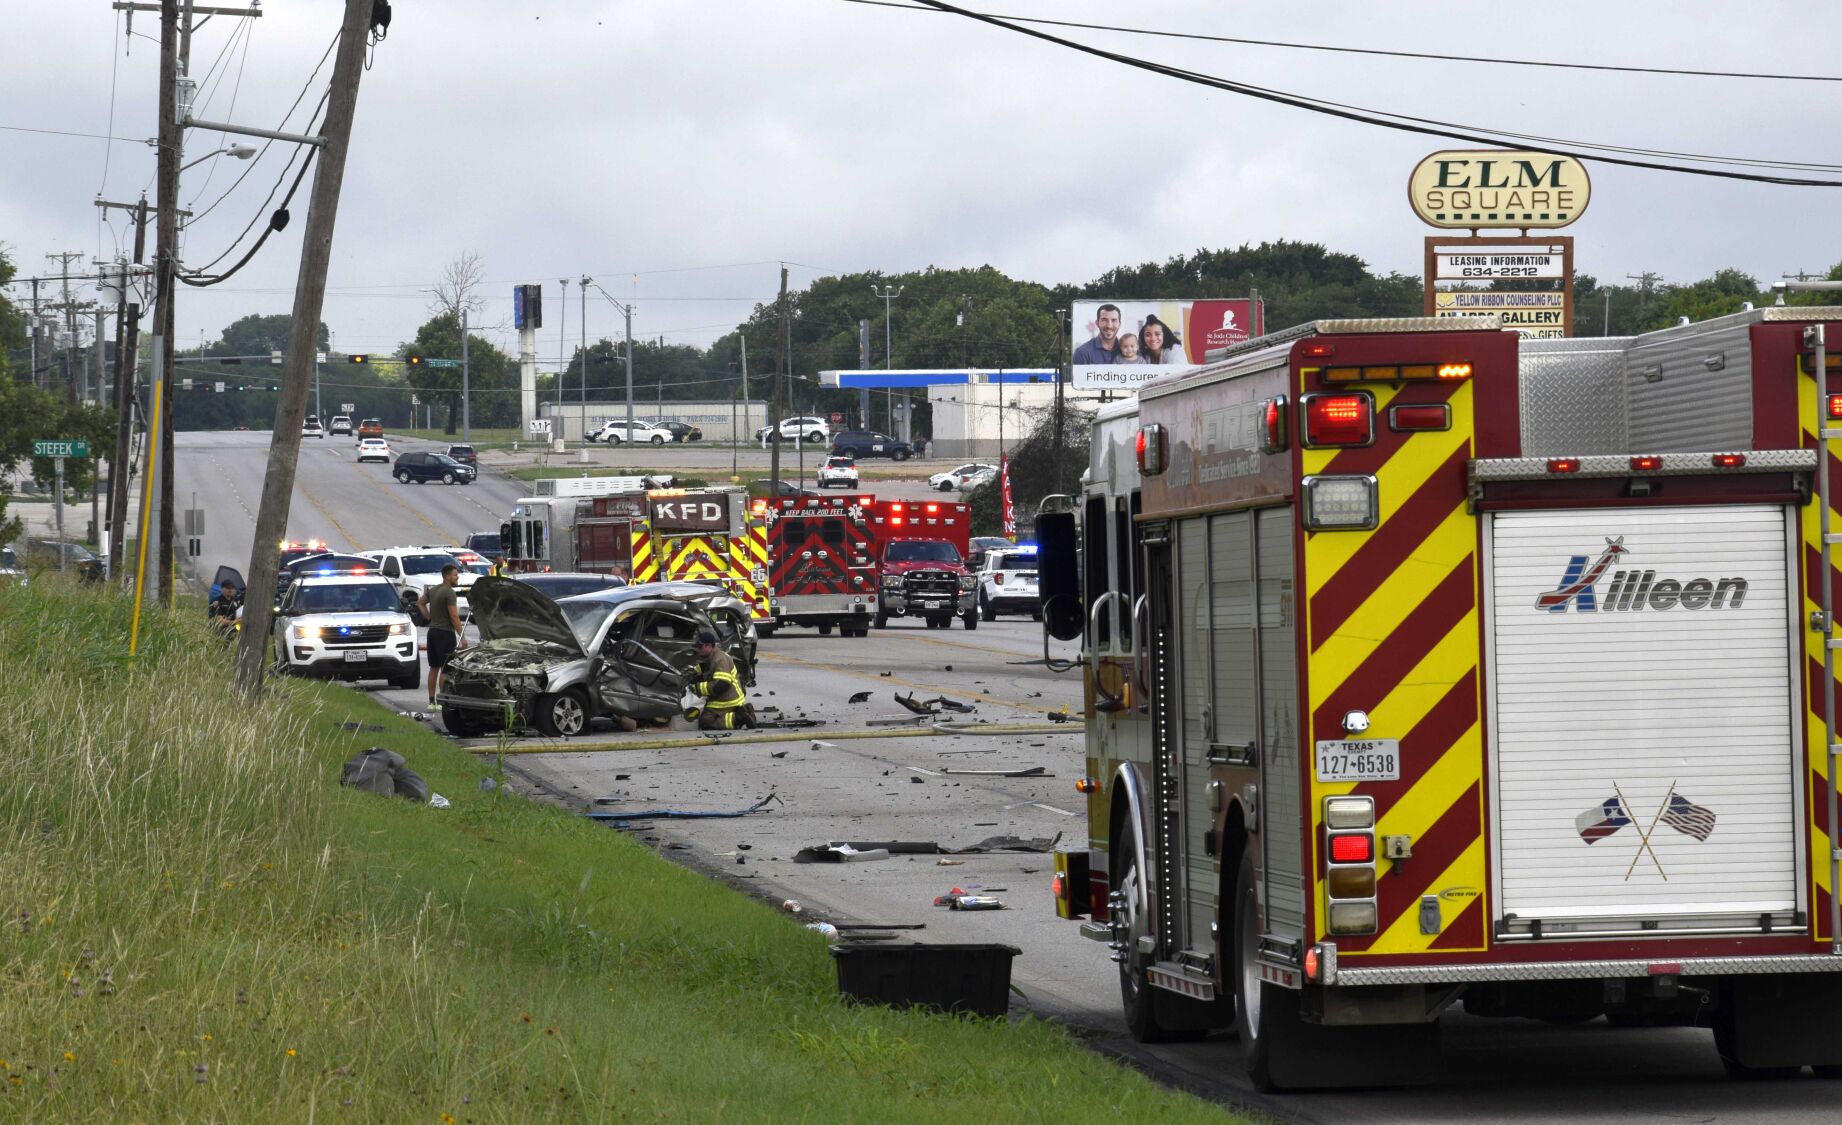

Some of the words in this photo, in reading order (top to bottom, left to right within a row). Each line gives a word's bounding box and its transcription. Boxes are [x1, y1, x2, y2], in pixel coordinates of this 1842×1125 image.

[1432, 160, 1567, 188] ELM
[1427, 191, 1573, 210] SQUARE
[1450, 256, 1487, 266] LEASING
[1490, 256, 1551, 266] INFORMATION
[1462, 267, 1538, 276] 634-2212
[1455, 295, 1480, 307] YELLOW
[1481, 294, 1504, 306] RIBBON
[1506, 294, 1546, 306] COUNSELING
[1547, 294, 1562, 305] PLLC
[1501, 311, 1561, 323] GALLERY
[1538, 329, 1563, 340] GIFTS
[1086, 371, 1127, 384] Finding
[34, 442, 73, 455] STEFEK
[656, 502, 722, 521] KFD
[750, 567, 765, 581] E6
[1534, 537, 1749, 613] Killeen
[1342, 742, 1374, 751] TEXAS
